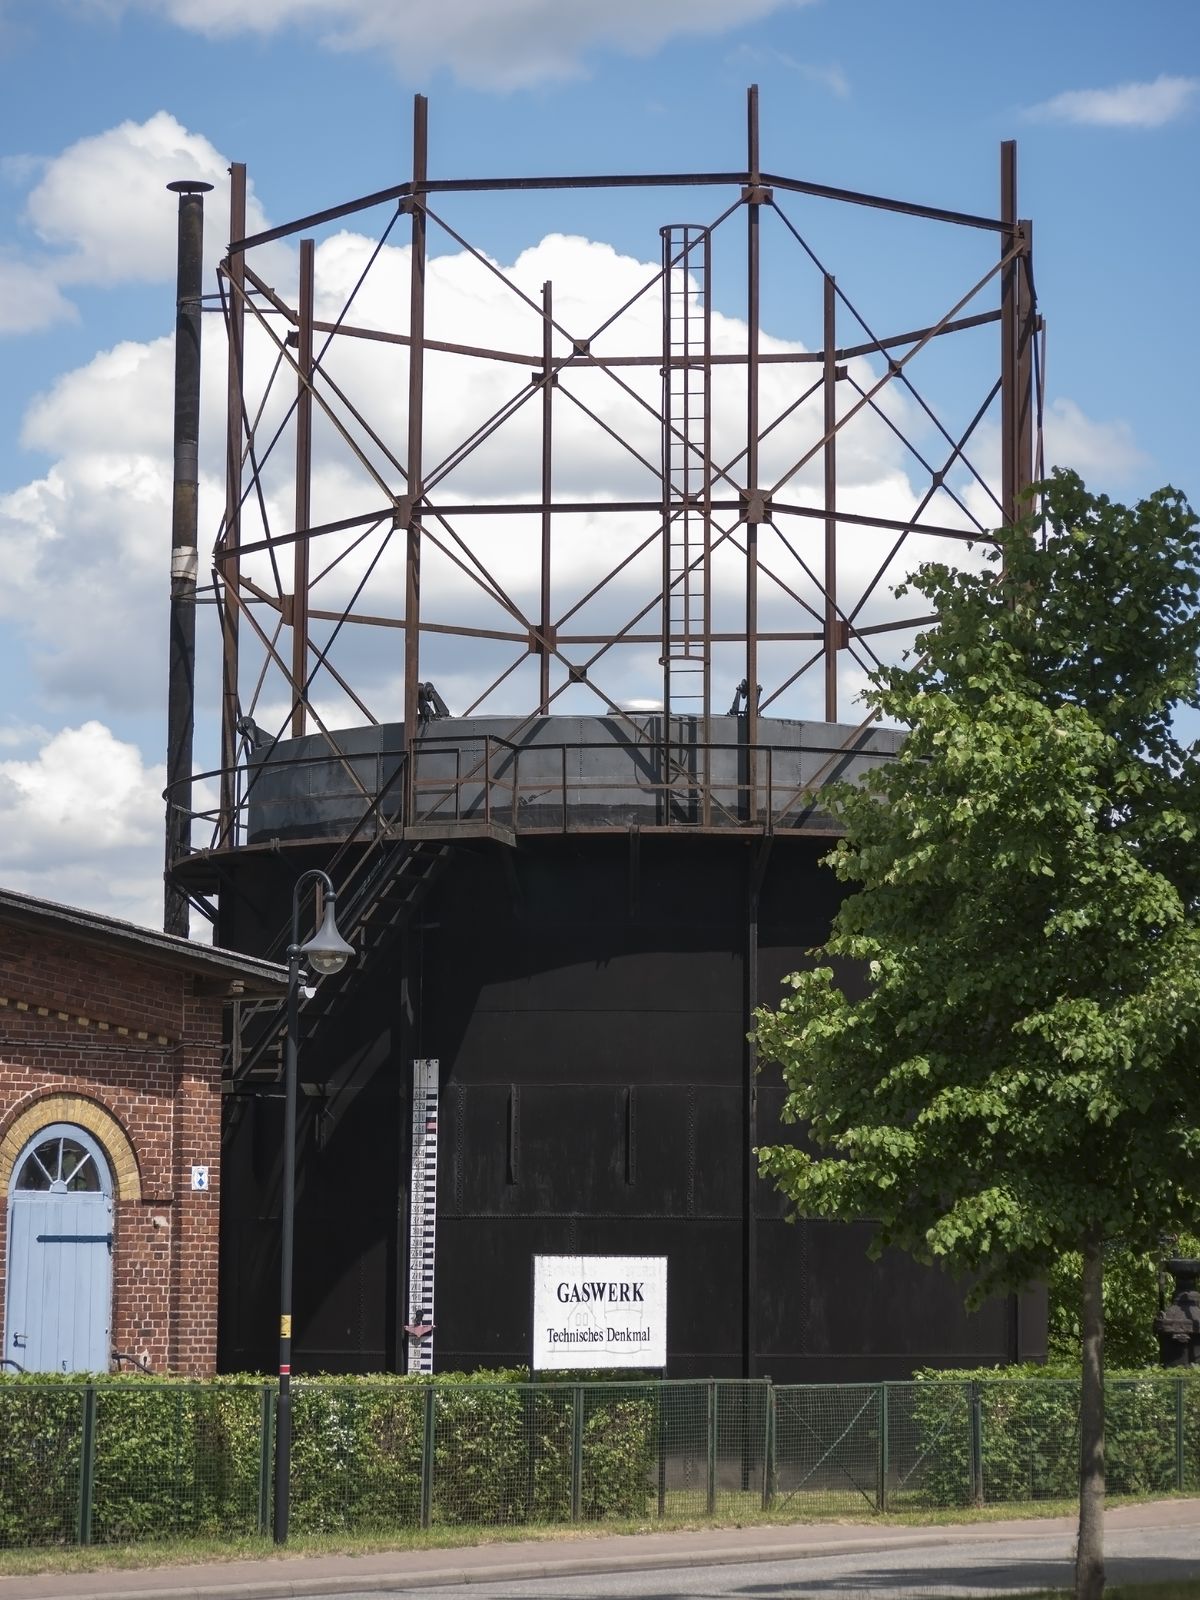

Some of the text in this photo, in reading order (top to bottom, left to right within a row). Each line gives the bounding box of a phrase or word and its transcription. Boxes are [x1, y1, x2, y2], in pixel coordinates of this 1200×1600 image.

[557, 1282, 644, 1303] GASWERK
[547, 1327, 650, 1343] Technisches Denkmal
